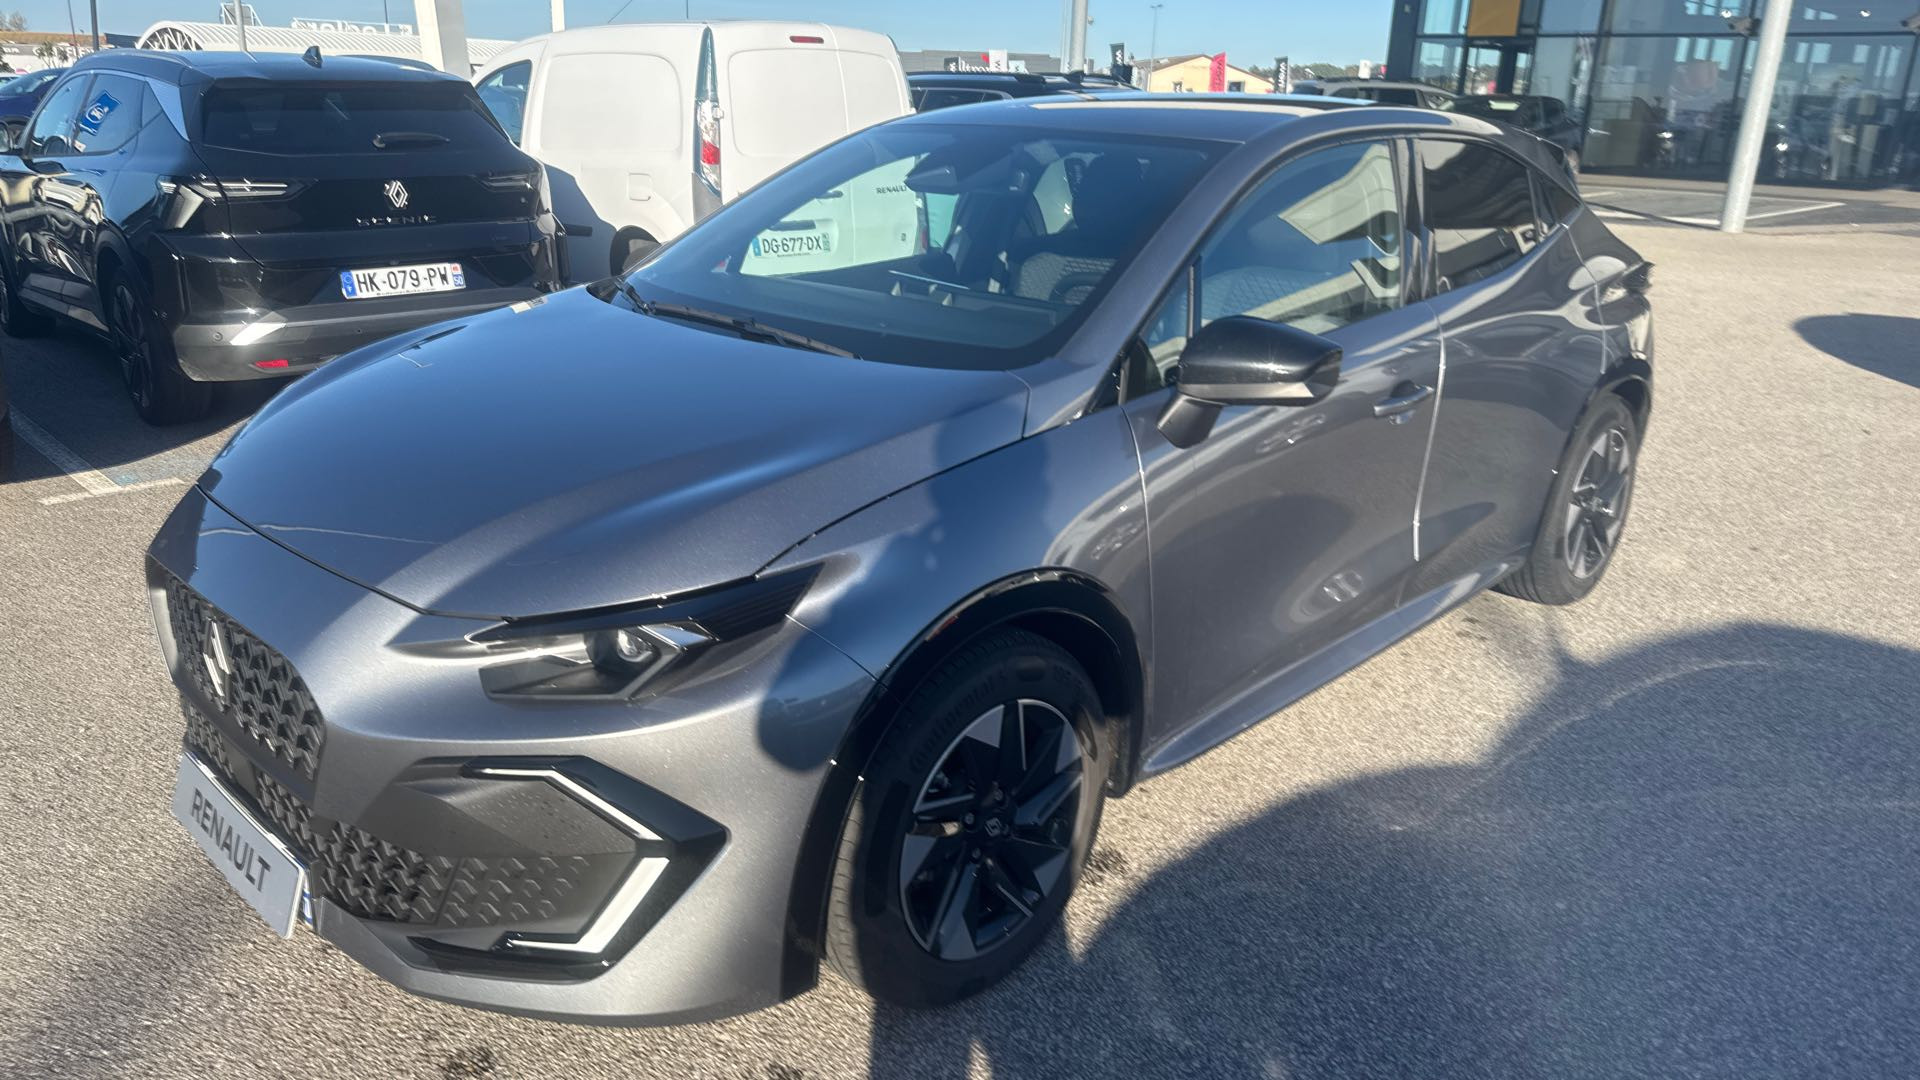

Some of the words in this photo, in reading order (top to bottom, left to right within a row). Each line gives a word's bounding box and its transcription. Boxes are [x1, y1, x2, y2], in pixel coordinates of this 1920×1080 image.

[356, 214, 437, 226] SCENIC
[762, 235, 822, 254] DG-677-DX
[355, 267, 449, 292] HK-079-PW
[191, 788, 270, 891] RENAULT
